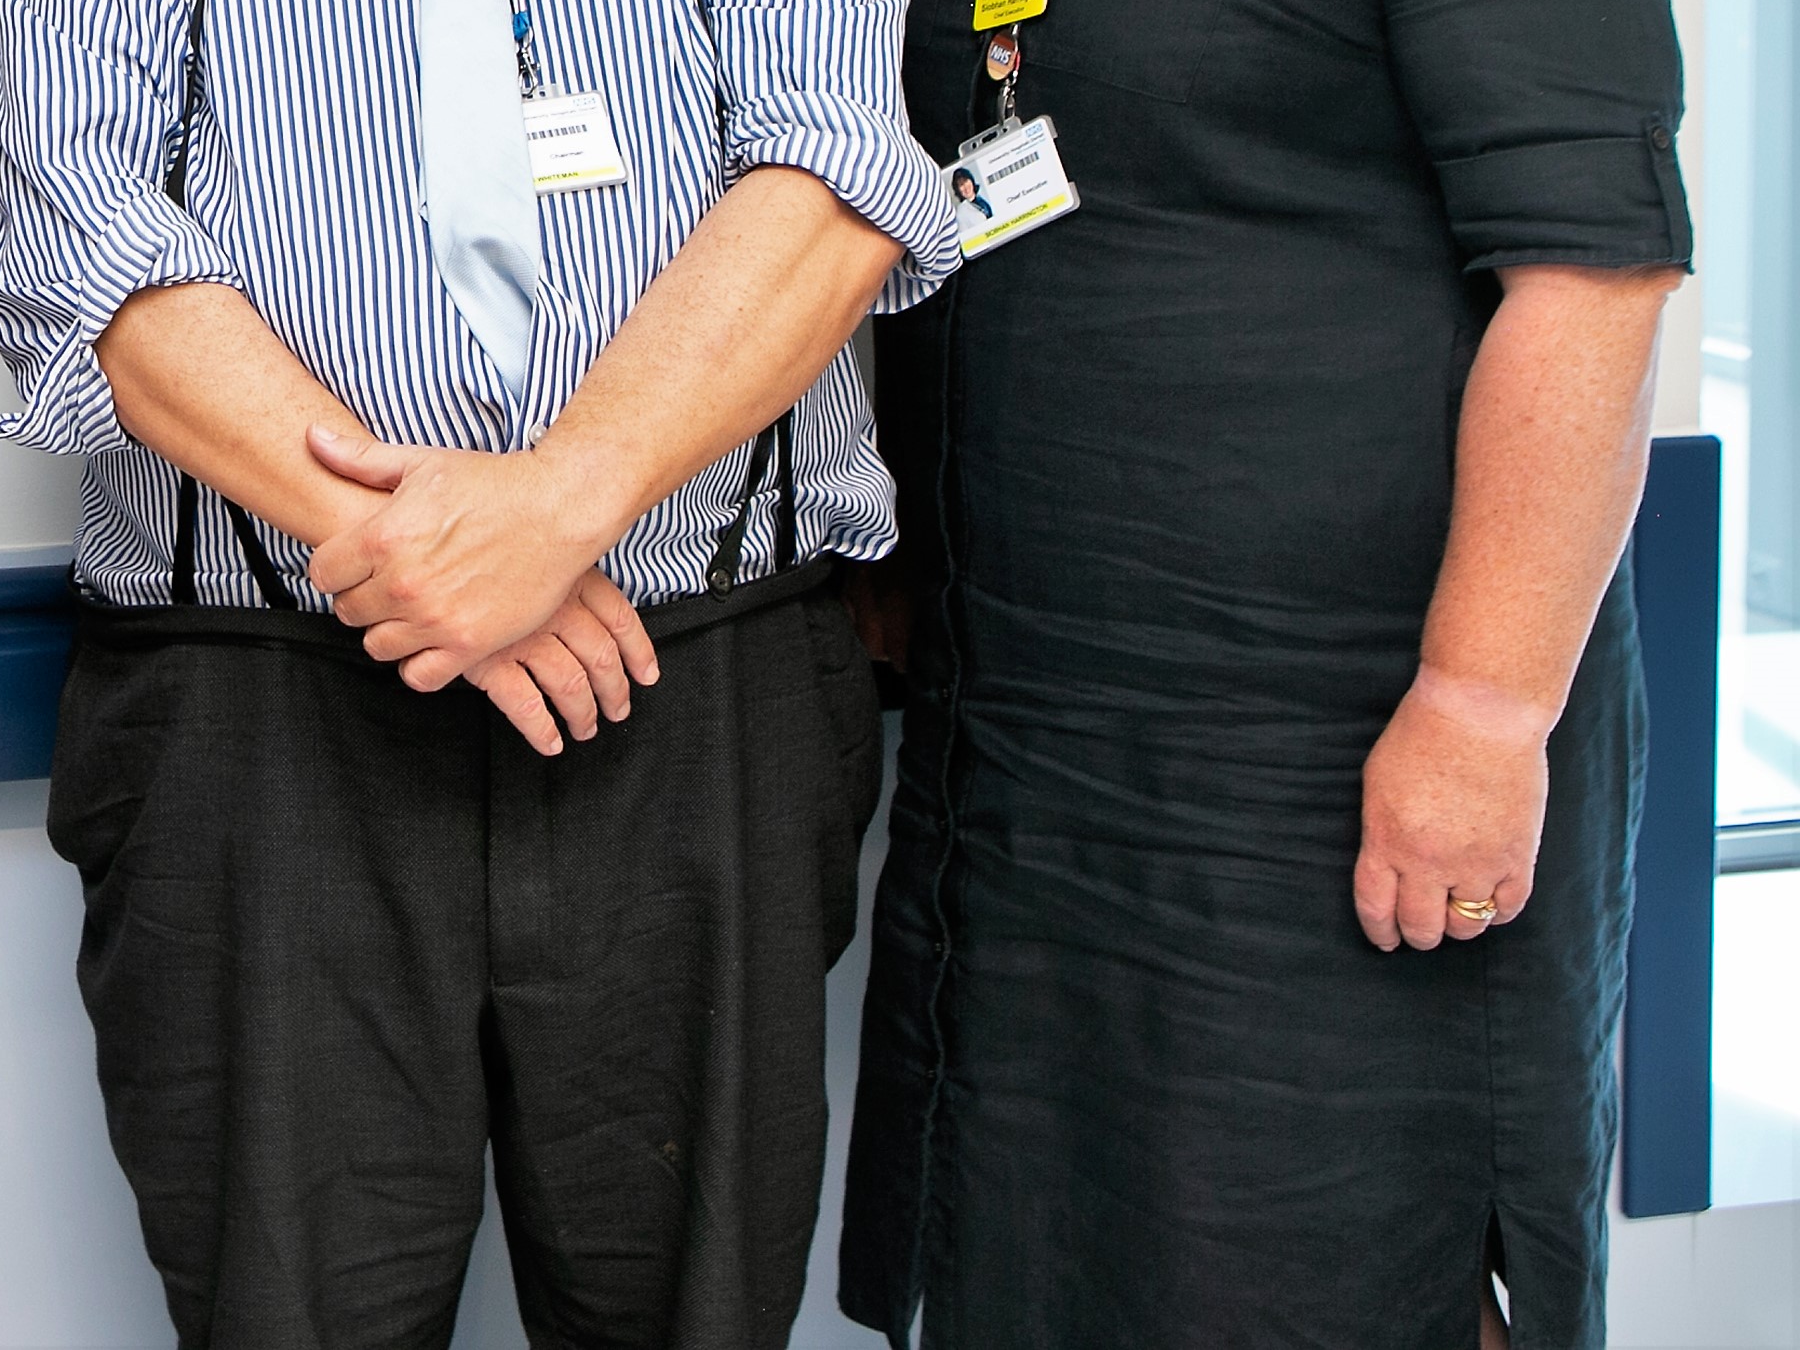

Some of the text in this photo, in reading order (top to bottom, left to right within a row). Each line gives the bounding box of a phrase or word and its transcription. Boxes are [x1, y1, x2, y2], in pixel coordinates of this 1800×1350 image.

[990, 45, 1011, 65] NHS
[537, 171, 579, 183] WHITEMAN
[1006, 193, 1021, 204] Chief
